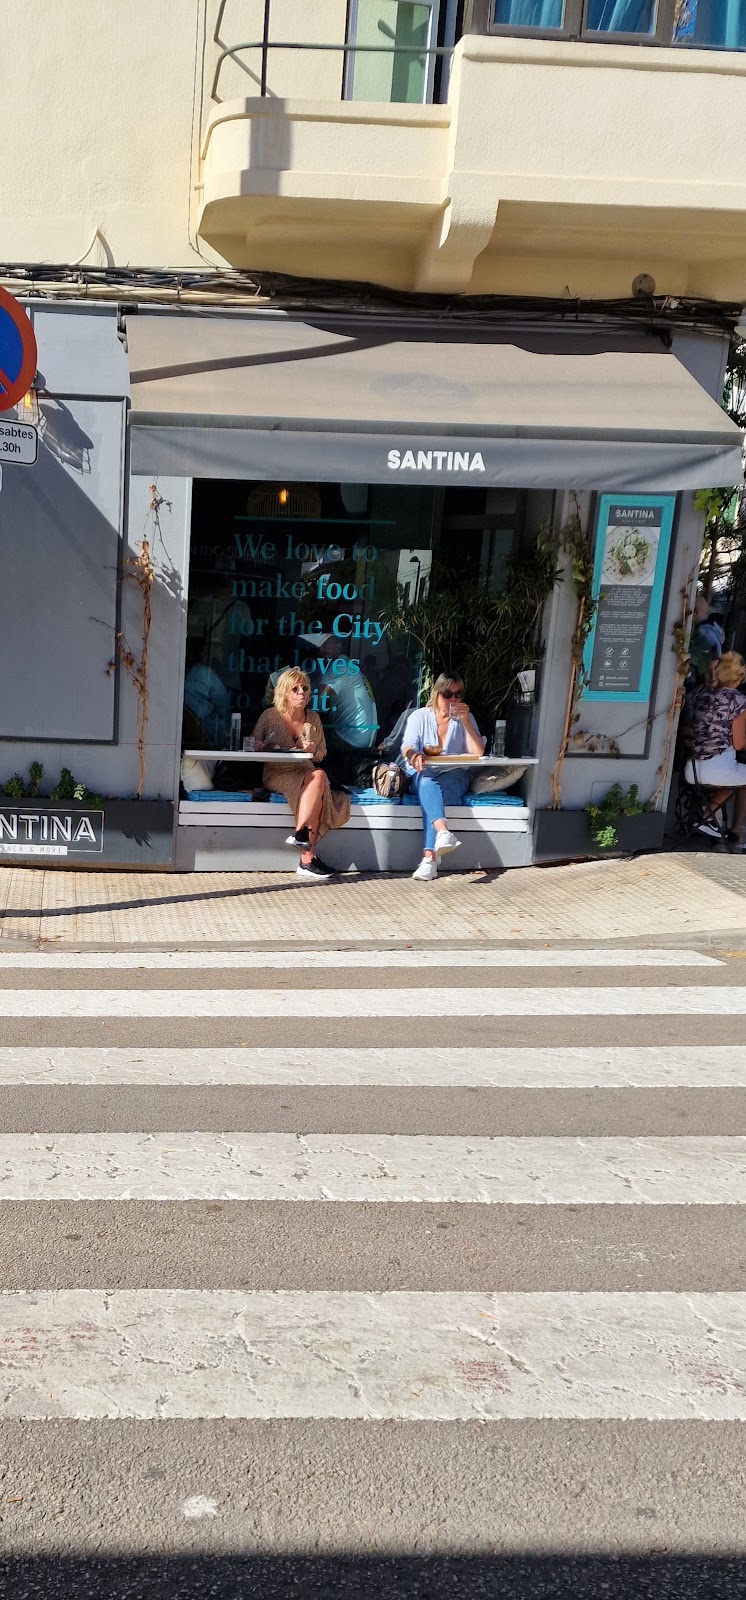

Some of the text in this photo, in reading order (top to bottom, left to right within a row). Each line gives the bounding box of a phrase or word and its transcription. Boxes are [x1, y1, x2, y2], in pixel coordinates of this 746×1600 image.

[0, 427, 33, 440] sabtes
[387, 449, 486, 471] SANTINA
[615, 509, 655, 519] SANTINA
[233, 533, 276, 560] We
[286, 533, 341, 562] love
[352, 542, 378, 562] to
[230, 573, 375, 600] make food
[227, 611, 388, 645] for the City
[227, 648, 361, 675] that loves
[311, 688, 338, 712] it.
[0, 814, 97, 842] NTINA
[40, 846, 62, 854] MORE
